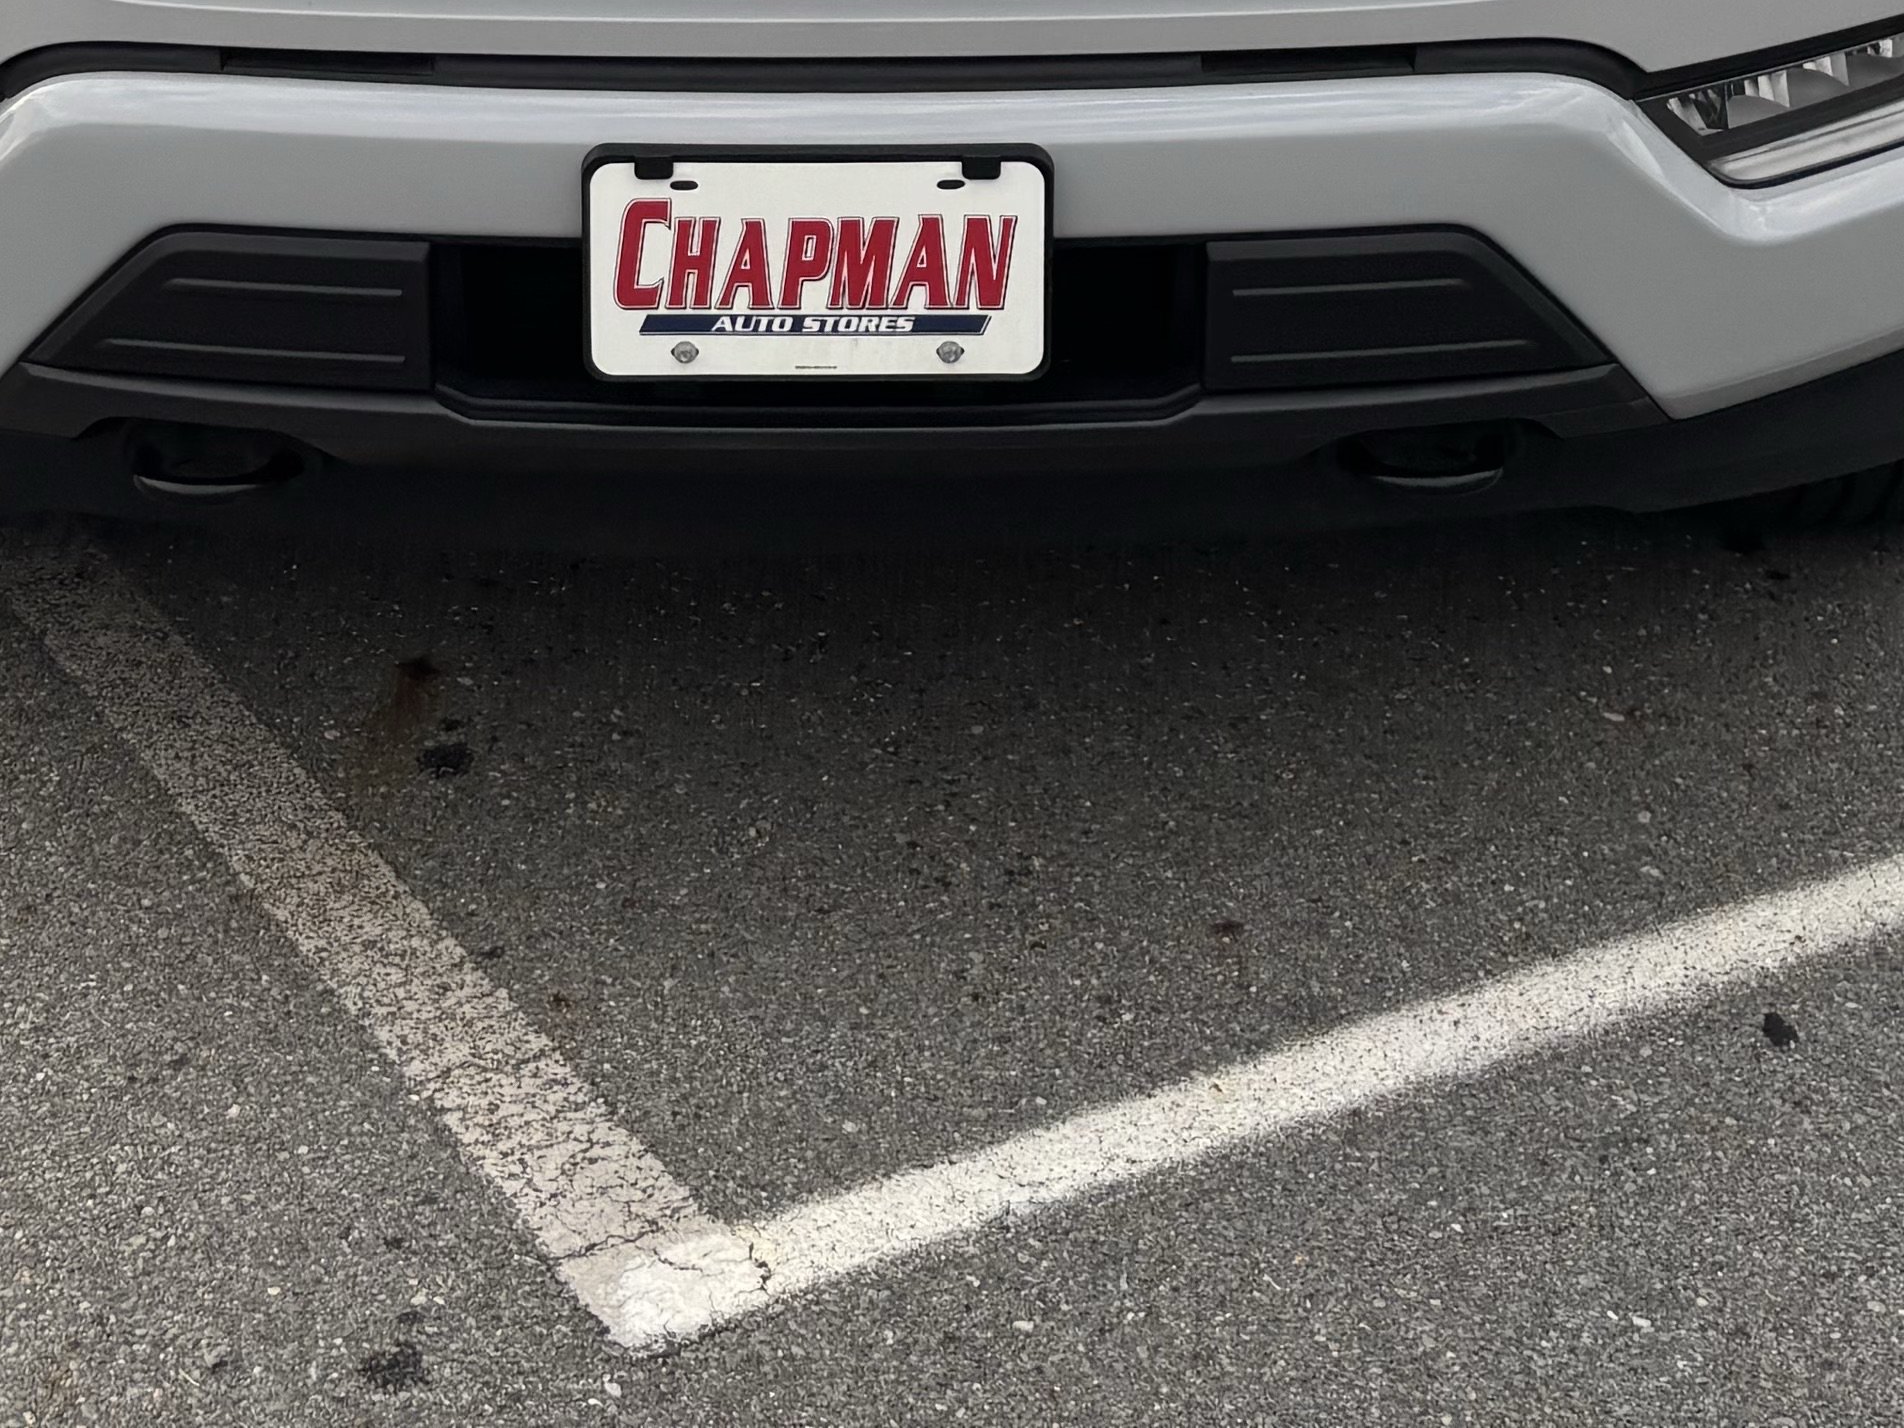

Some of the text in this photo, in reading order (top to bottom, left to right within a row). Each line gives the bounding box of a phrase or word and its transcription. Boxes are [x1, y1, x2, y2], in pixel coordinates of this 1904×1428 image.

[613, 197, 1018, 312] CHAPMAN
[711, 316, 916, 332] AUTO STORES
